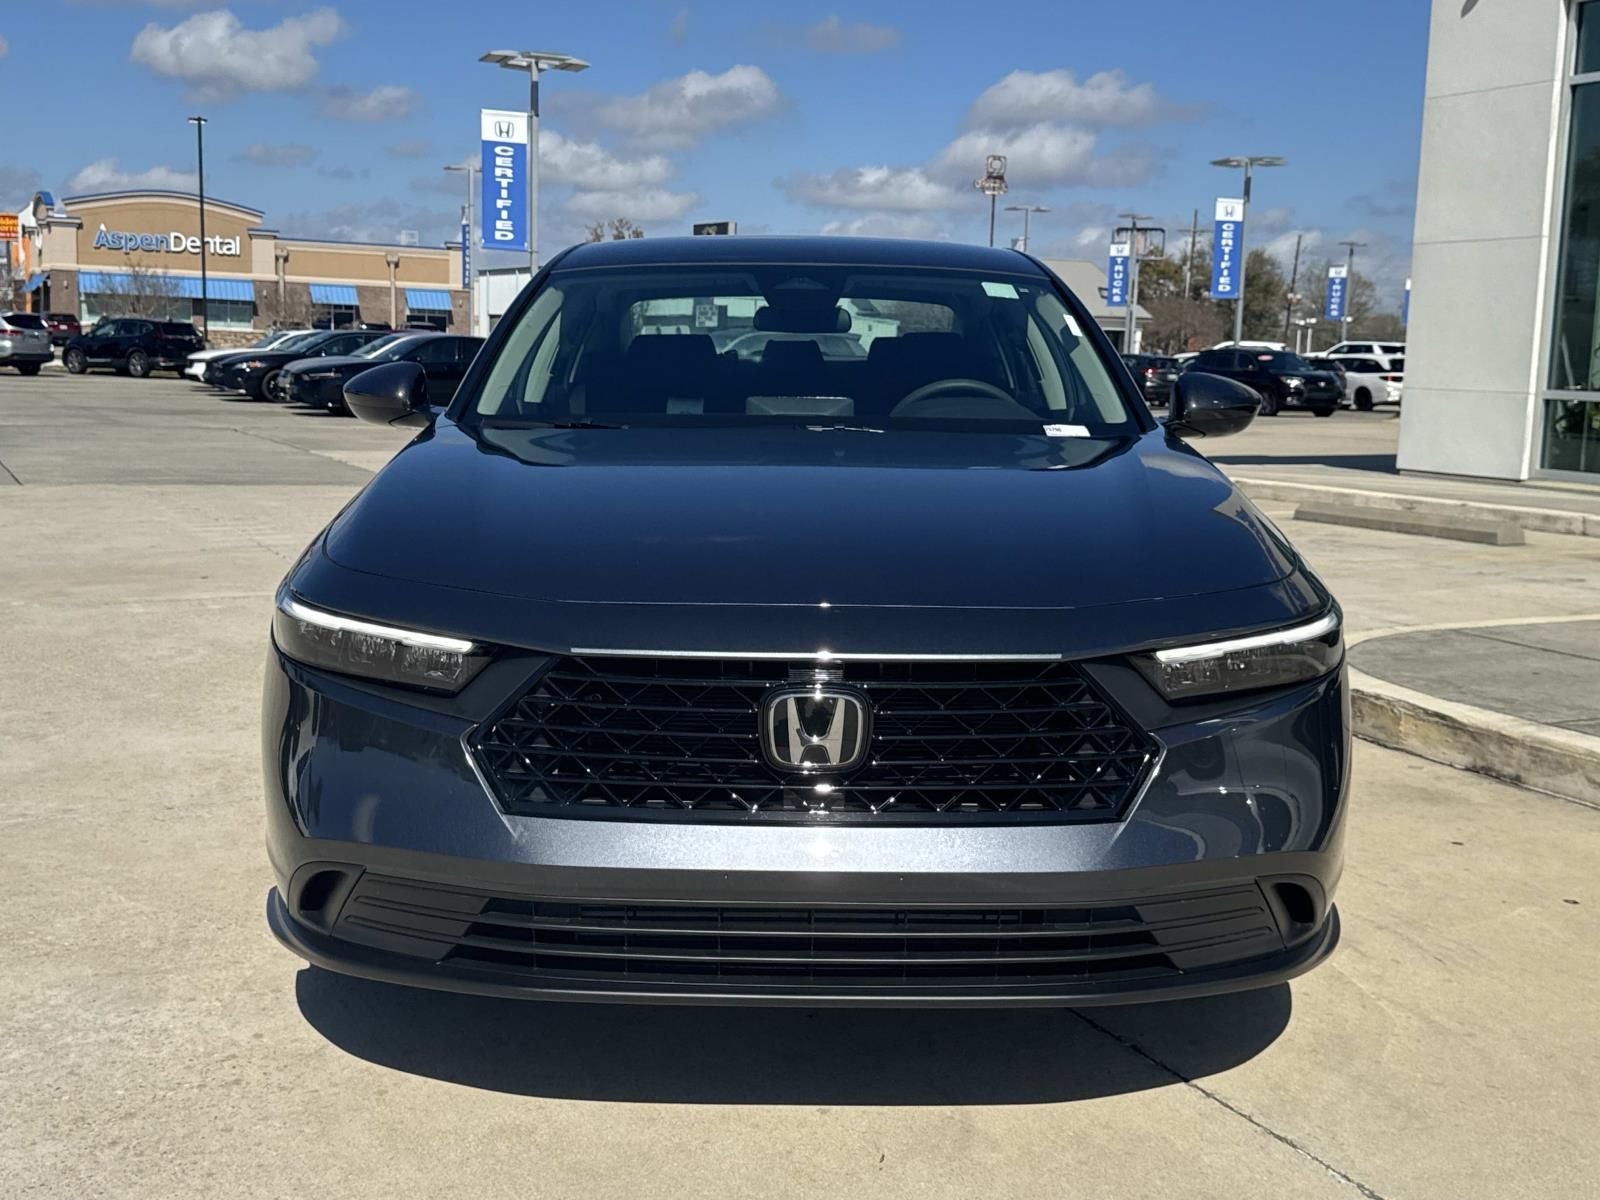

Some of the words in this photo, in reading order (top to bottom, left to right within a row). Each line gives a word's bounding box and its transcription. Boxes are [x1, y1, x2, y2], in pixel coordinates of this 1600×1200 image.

[494, 146, 514, 240] CERTIFIED
[1112, 257, 1123, 302] TRUCKS
[1218, 223, 1234, 292] CERTIFIED
